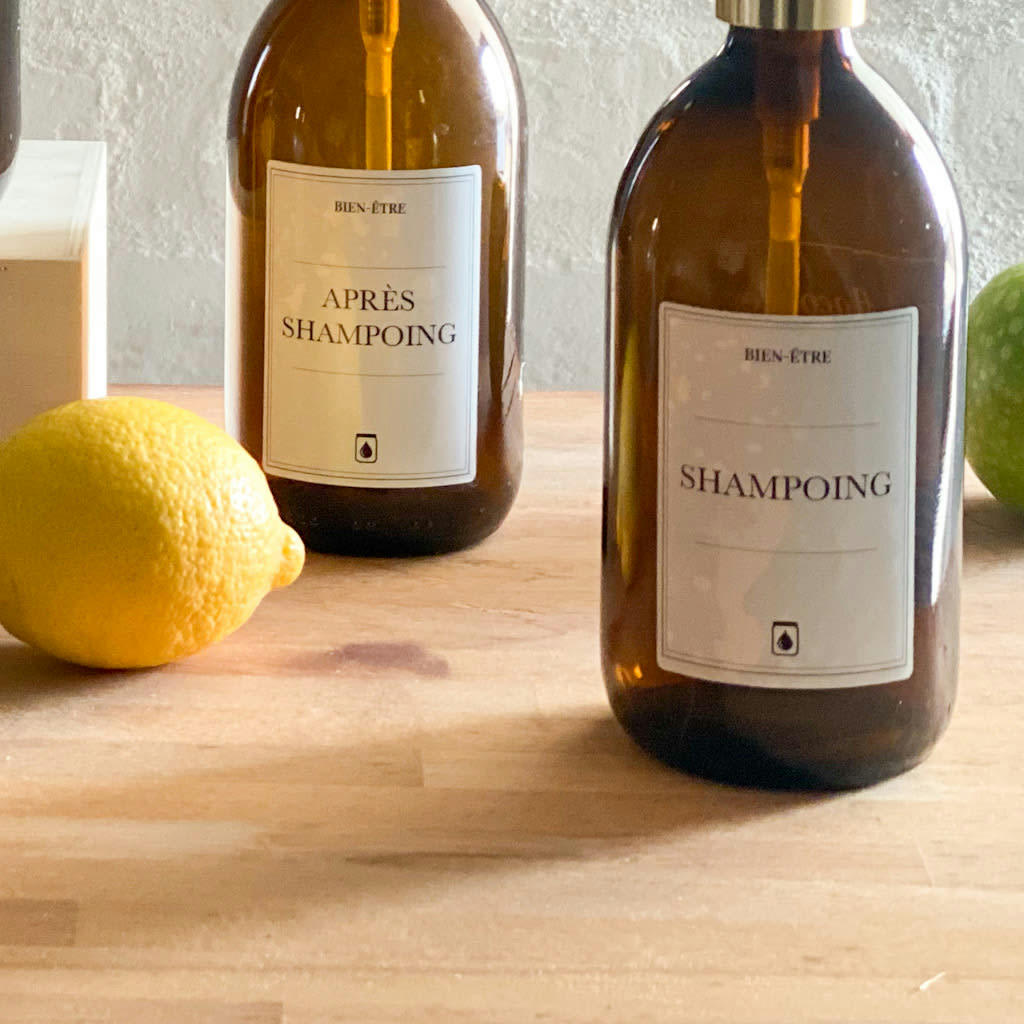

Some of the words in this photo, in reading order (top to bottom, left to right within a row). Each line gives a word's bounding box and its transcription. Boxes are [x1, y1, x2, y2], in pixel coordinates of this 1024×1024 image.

[334, 200, 407, 215] BIEN-ÊTRE
[321, 284, 415, 312] APRÈS
[281, 316, 456, 347] SHAMPOING
[744, 347, 832, 365] BIEN-ÊTRE
[679, 463, 892, 502] SHAMPOING
